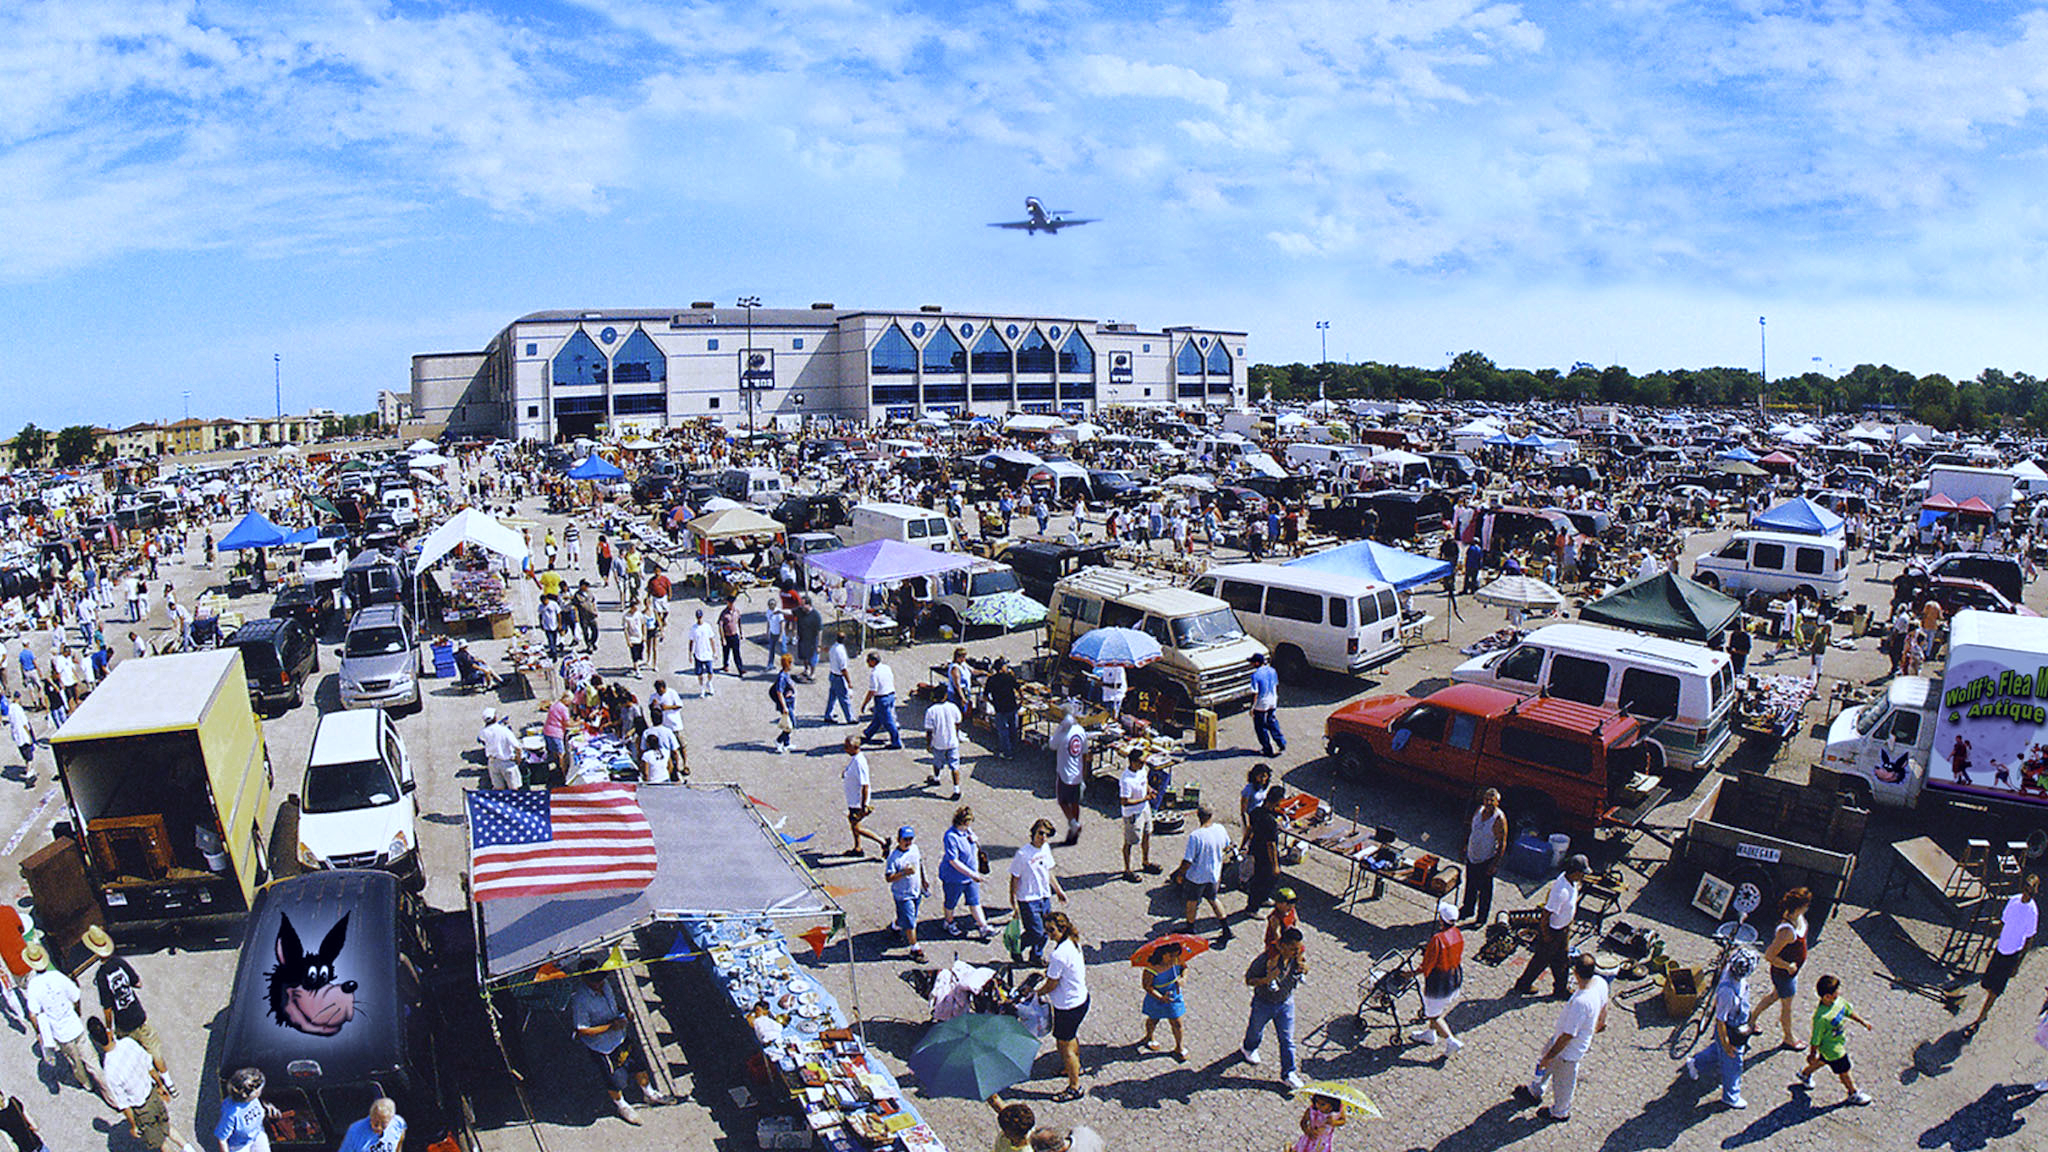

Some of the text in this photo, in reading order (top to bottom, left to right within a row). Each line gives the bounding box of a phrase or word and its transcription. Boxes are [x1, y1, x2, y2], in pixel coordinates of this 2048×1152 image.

[1946, 675, 1995, 706] Wolff's
[1998, 669, 2032, 697] Flea
[1966, 699, 2046, 724] Antique
